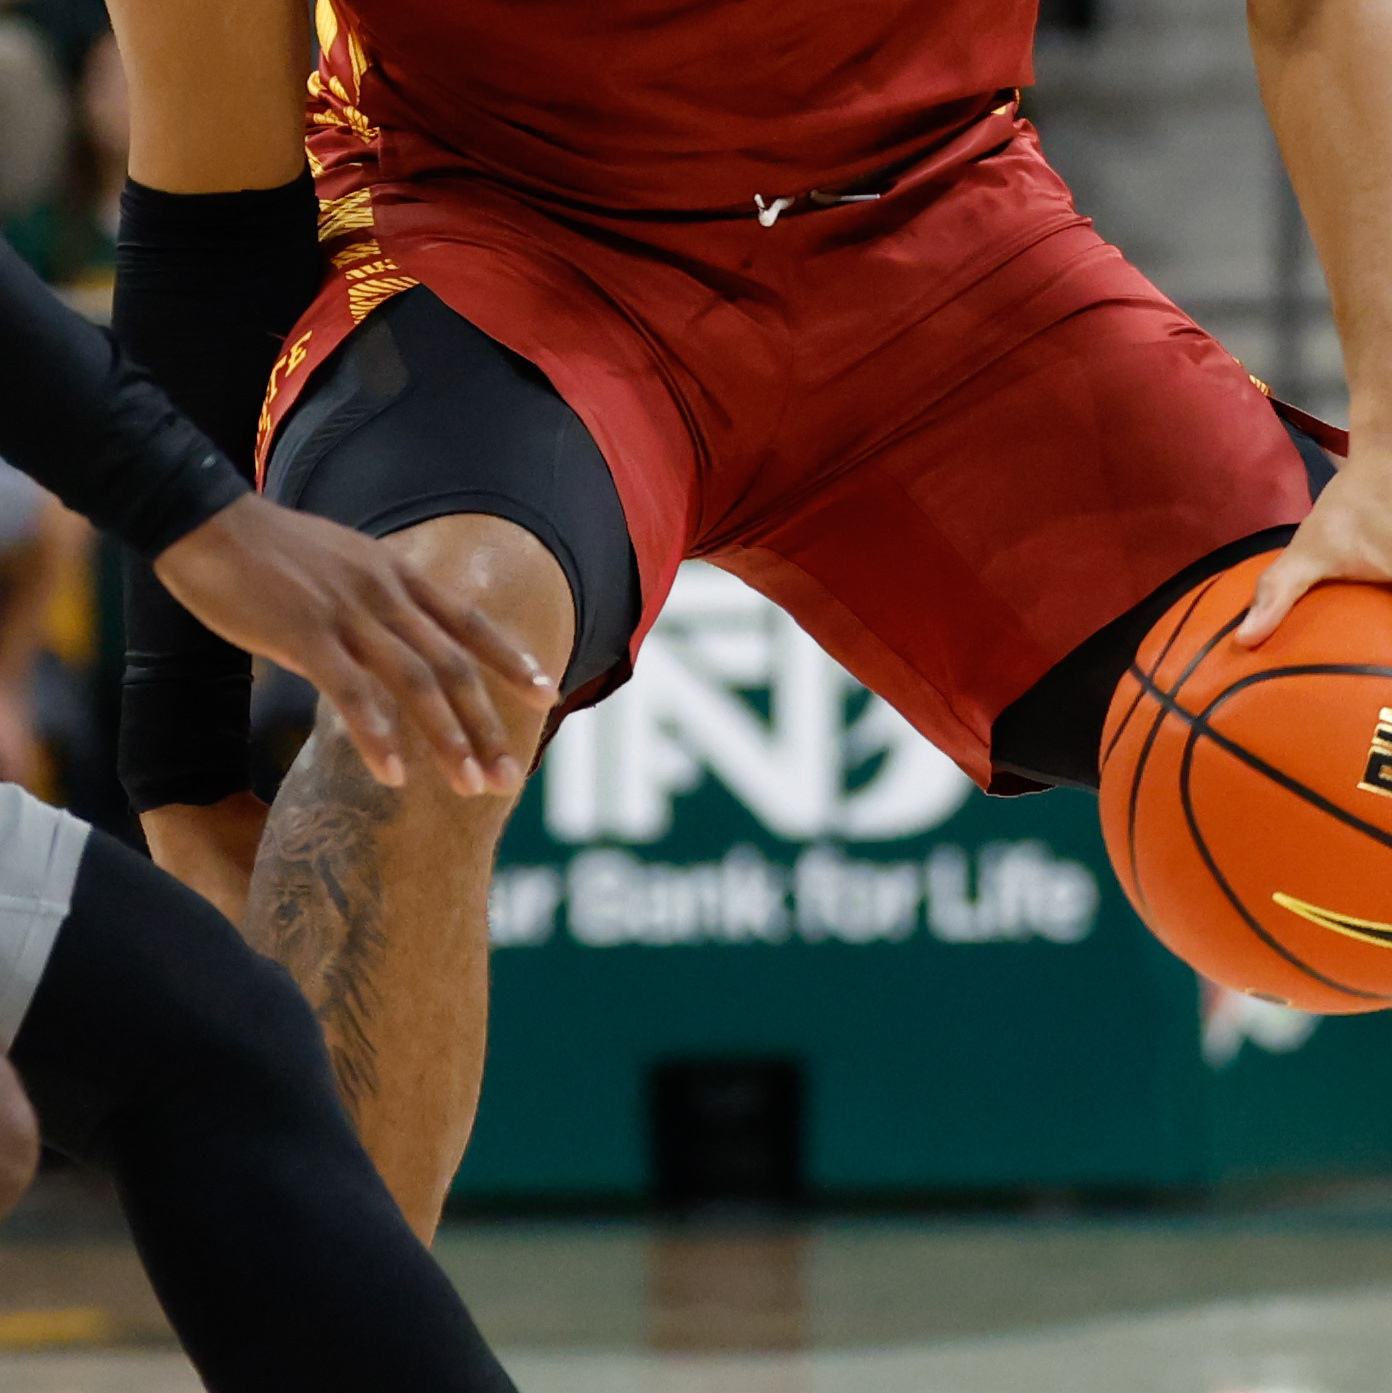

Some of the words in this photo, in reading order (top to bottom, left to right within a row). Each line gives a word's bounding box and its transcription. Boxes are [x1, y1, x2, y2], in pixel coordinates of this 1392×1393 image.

[567, 845, 790, 948] Bank
[795, 845, 920, 946] for
[925, 840, 1100, 945] Life
